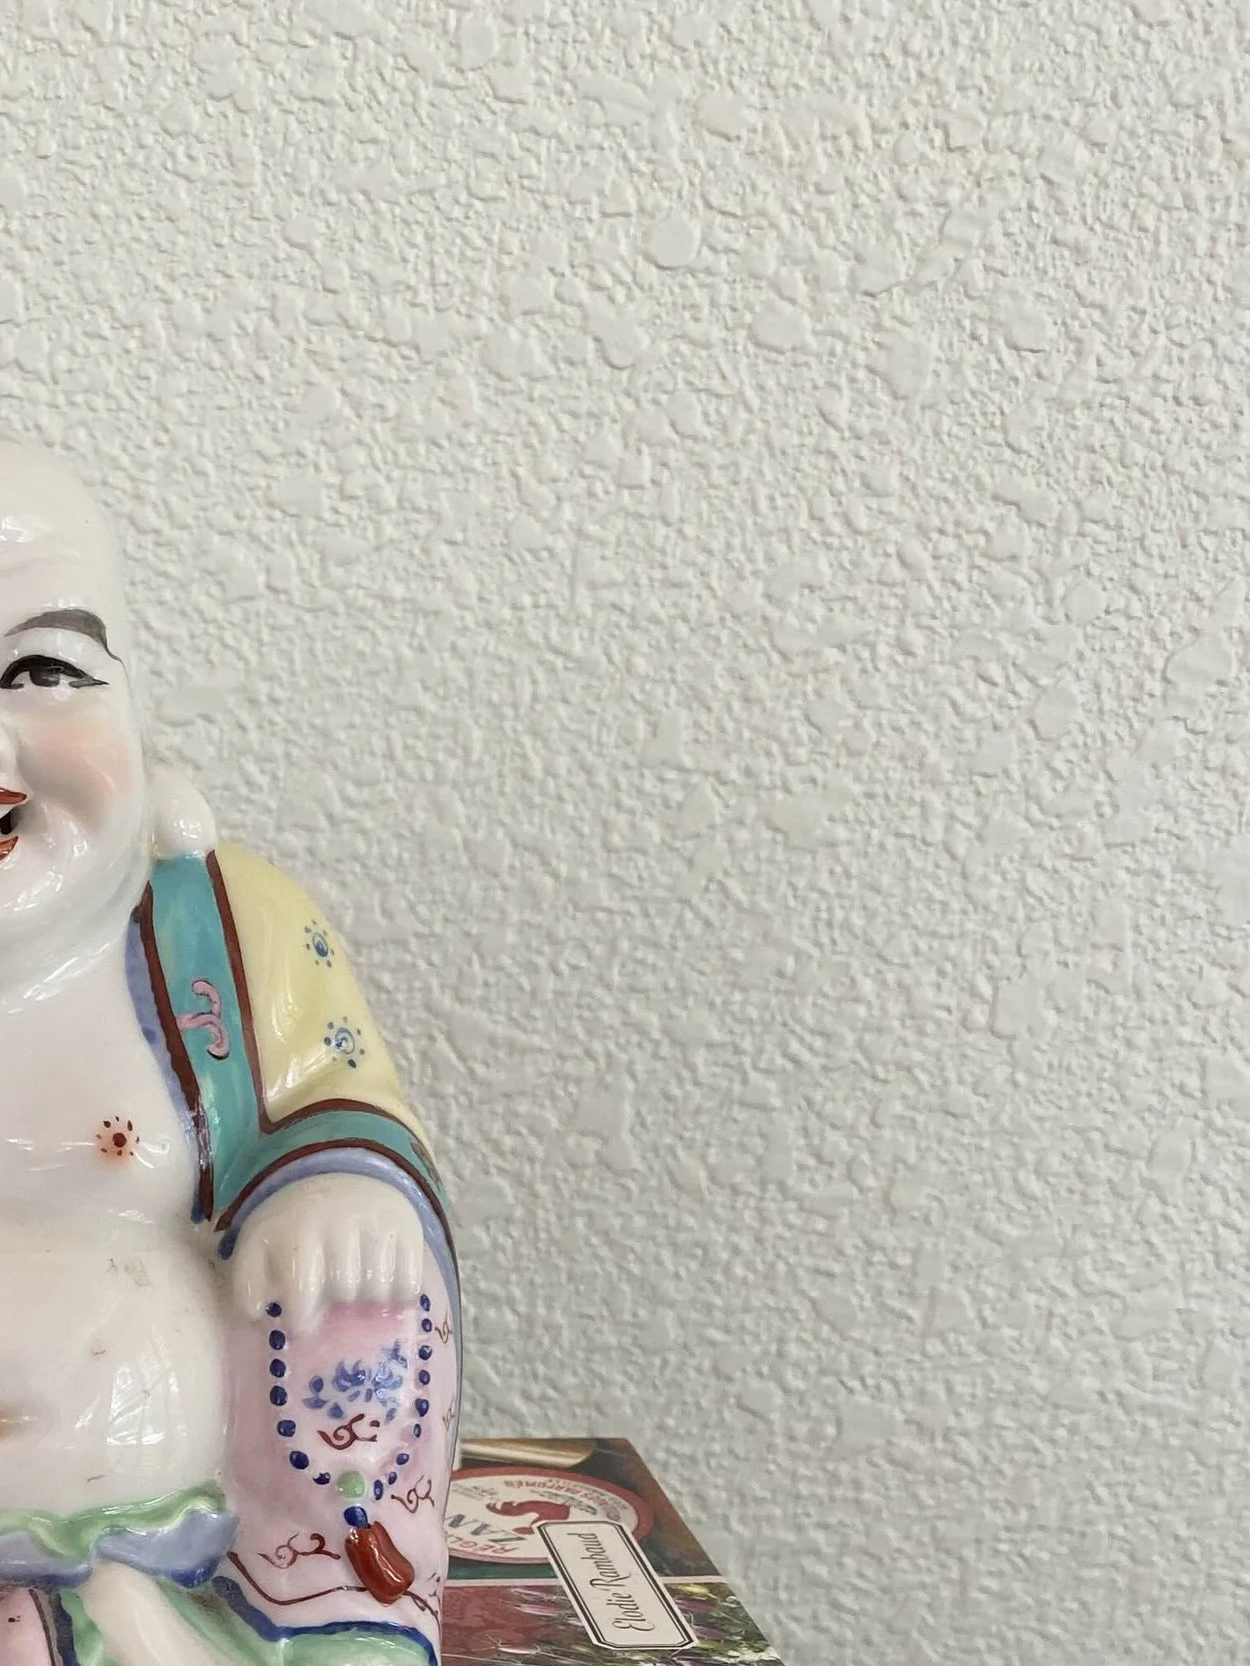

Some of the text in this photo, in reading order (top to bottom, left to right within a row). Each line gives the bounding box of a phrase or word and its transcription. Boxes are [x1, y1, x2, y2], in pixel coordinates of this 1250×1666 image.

[447, 1533, 519, 1556] REGL
[567, 1531, 631, 1592] Rambaud
[606, 1593, 655, 1632] Elodie
